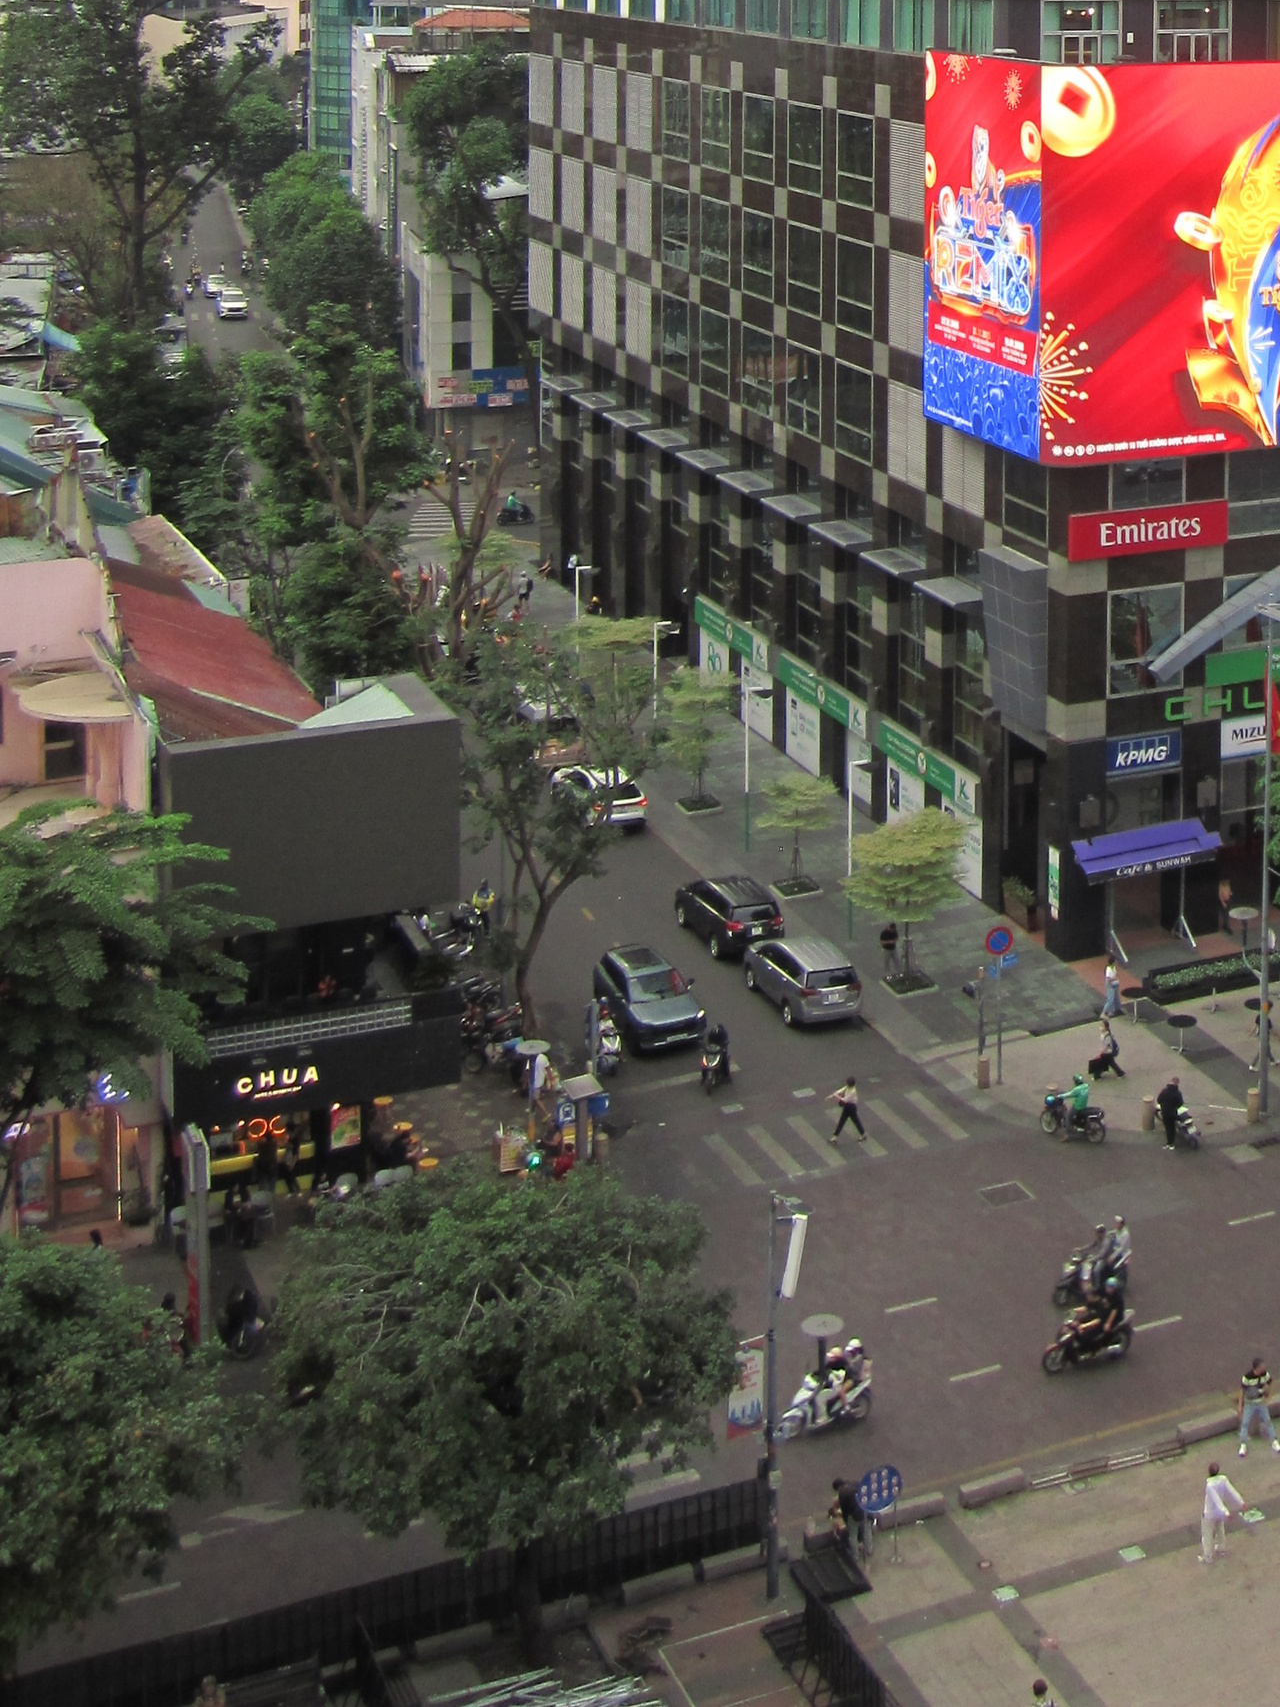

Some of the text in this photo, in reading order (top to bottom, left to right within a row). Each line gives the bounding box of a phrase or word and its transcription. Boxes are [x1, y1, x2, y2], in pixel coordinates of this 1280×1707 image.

[960, 186, 1004, 238] Tiger
[934, 235, 1032, 316] REMIX
[1100, 517, 1201, 546] Emirates
[1231, 725, 1266, 741] MIZU
[1115, 745, 1169, 768] KPMG
[1156, 856, 1192, 870] SUNWAH
[237, 1066, 319, 1094] CHUA
